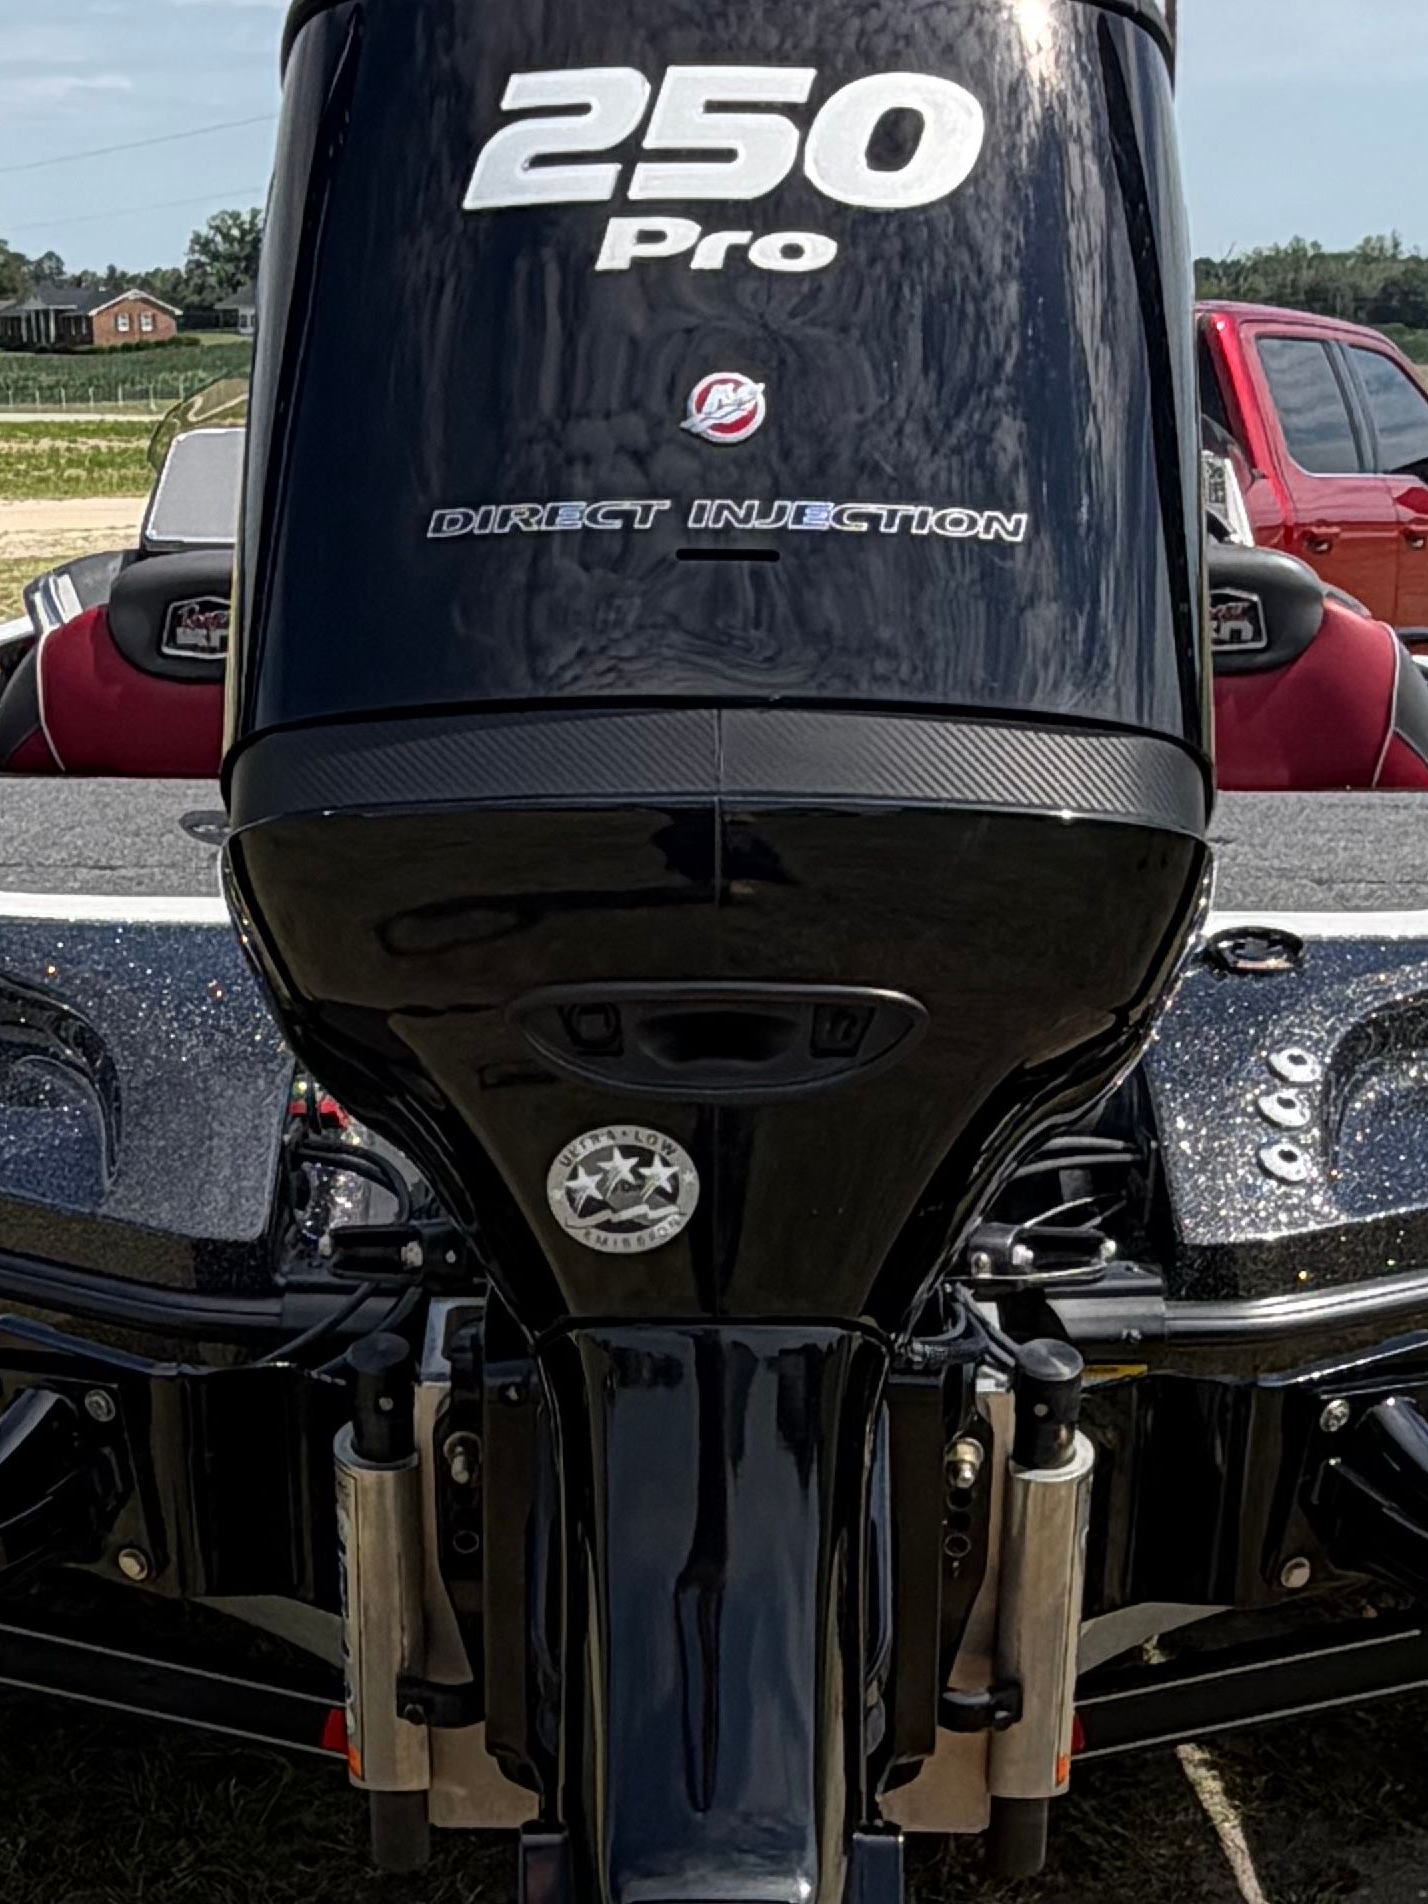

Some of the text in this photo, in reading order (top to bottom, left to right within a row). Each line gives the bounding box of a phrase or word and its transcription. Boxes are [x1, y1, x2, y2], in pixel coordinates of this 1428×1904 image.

[462, 65, 986, 210] 250
[594, 216, 838, 271] Pro
[427, 499, 1027, 542] DIRECT INJECTION
[634, 1130, 677, 1156] LOW
